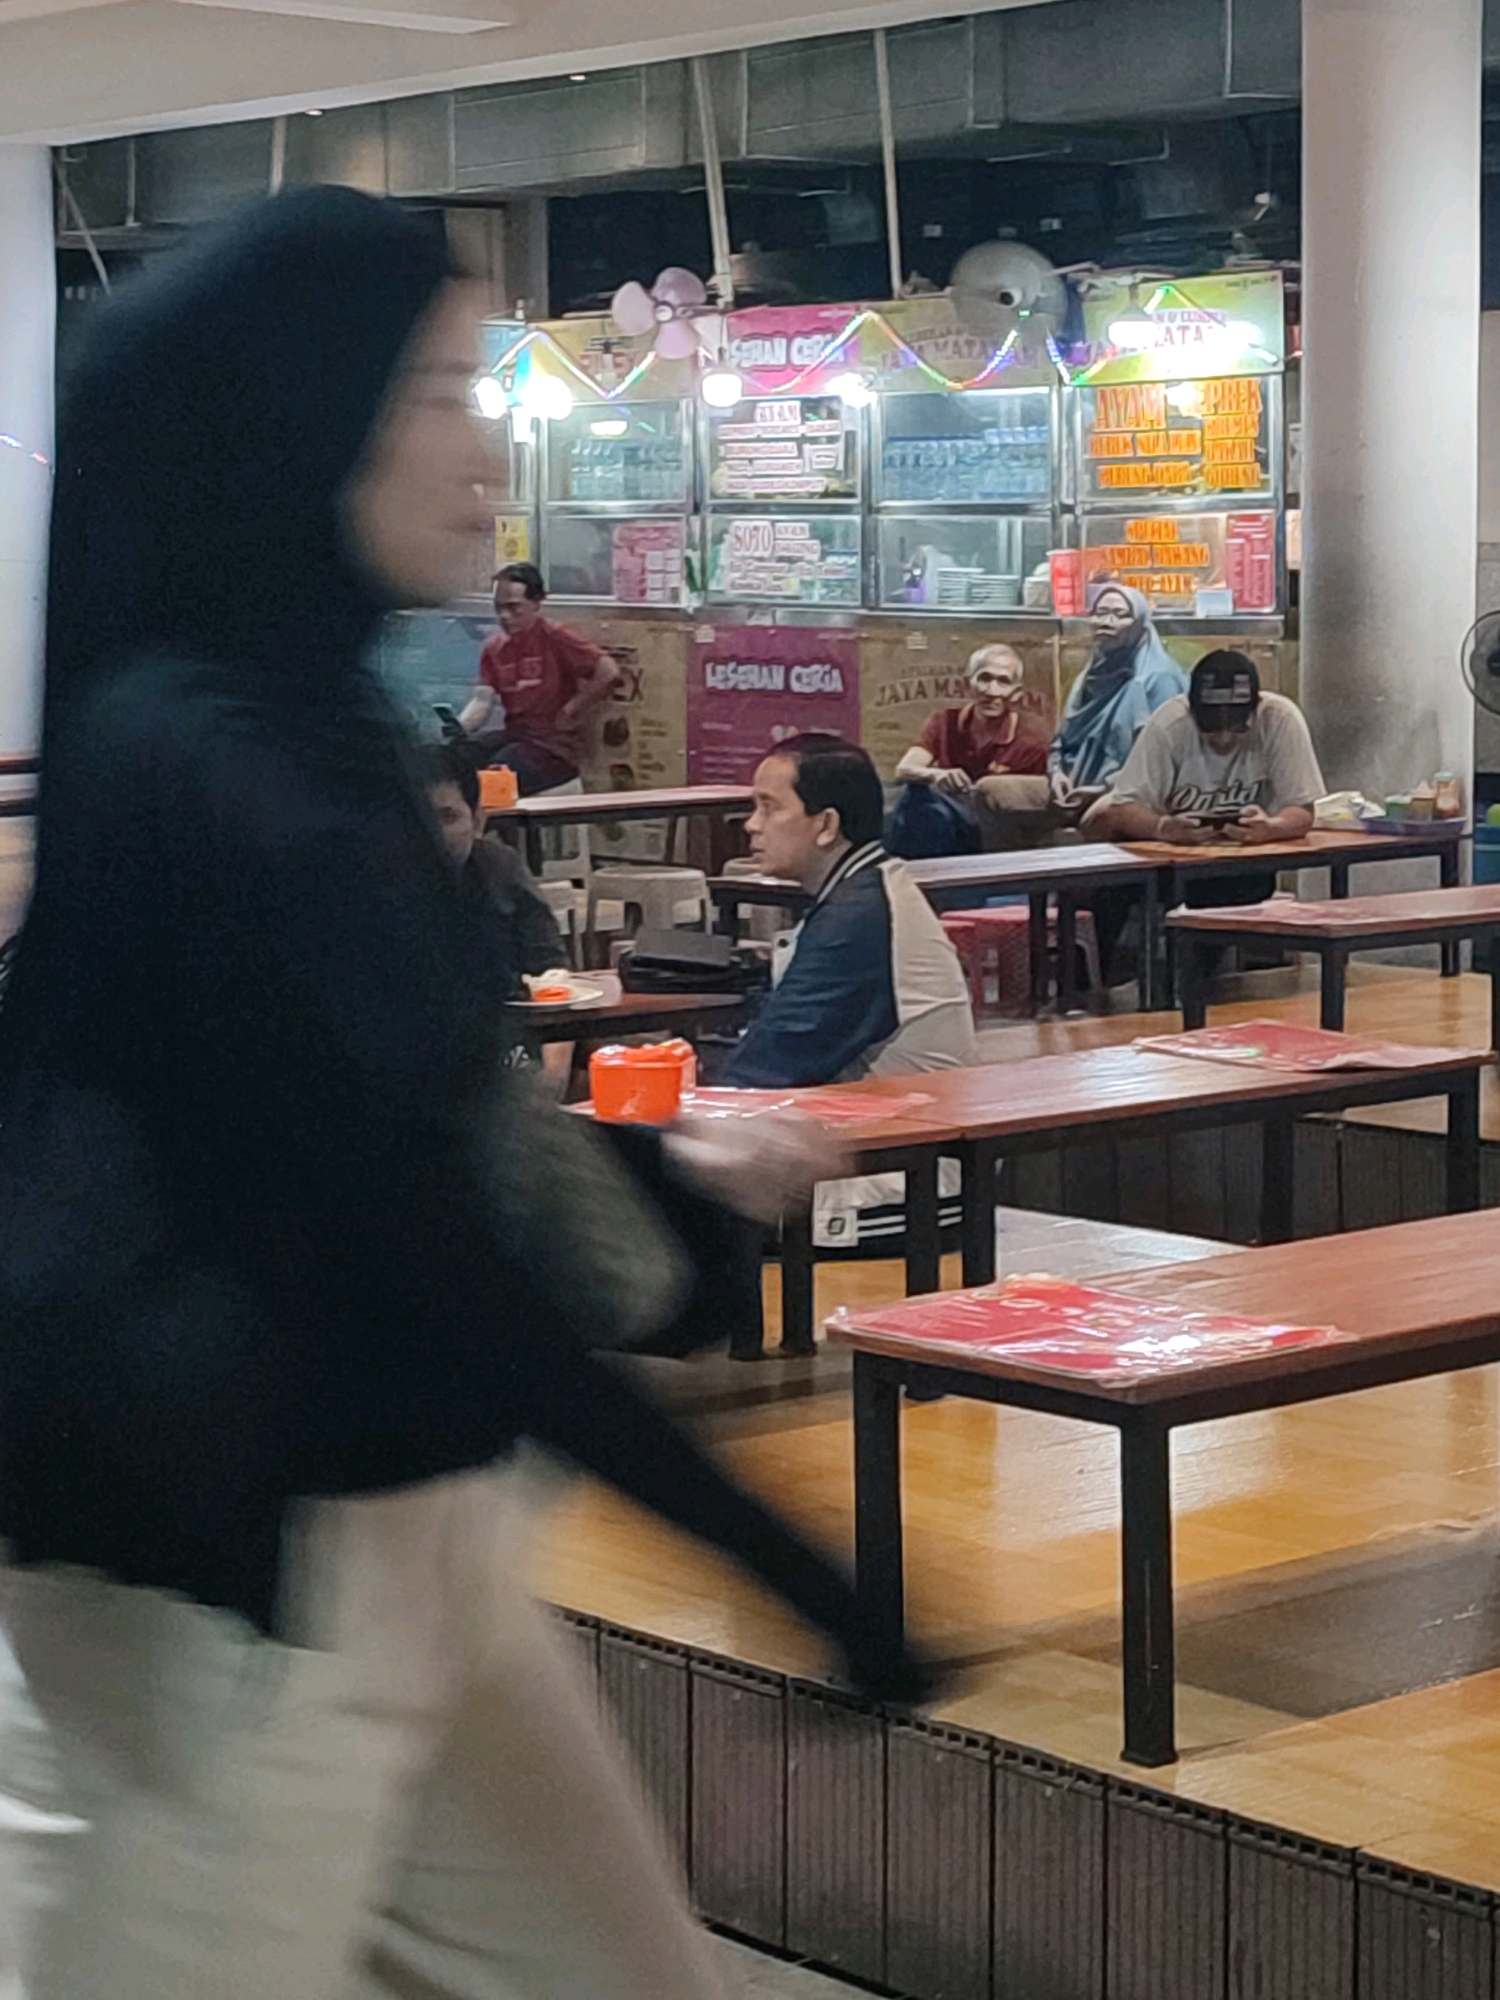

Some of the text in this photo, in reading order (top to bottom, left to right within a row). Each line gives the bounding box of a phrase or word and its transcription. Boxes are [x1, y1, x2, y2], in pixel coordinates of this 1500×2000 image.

[1096, 386, 1166, 429] AYAM
[733, 525, 771, 552] SOTO
[706, 662, 785, 690] LESEHAN
[874, 680, 929, 707] JAYA
